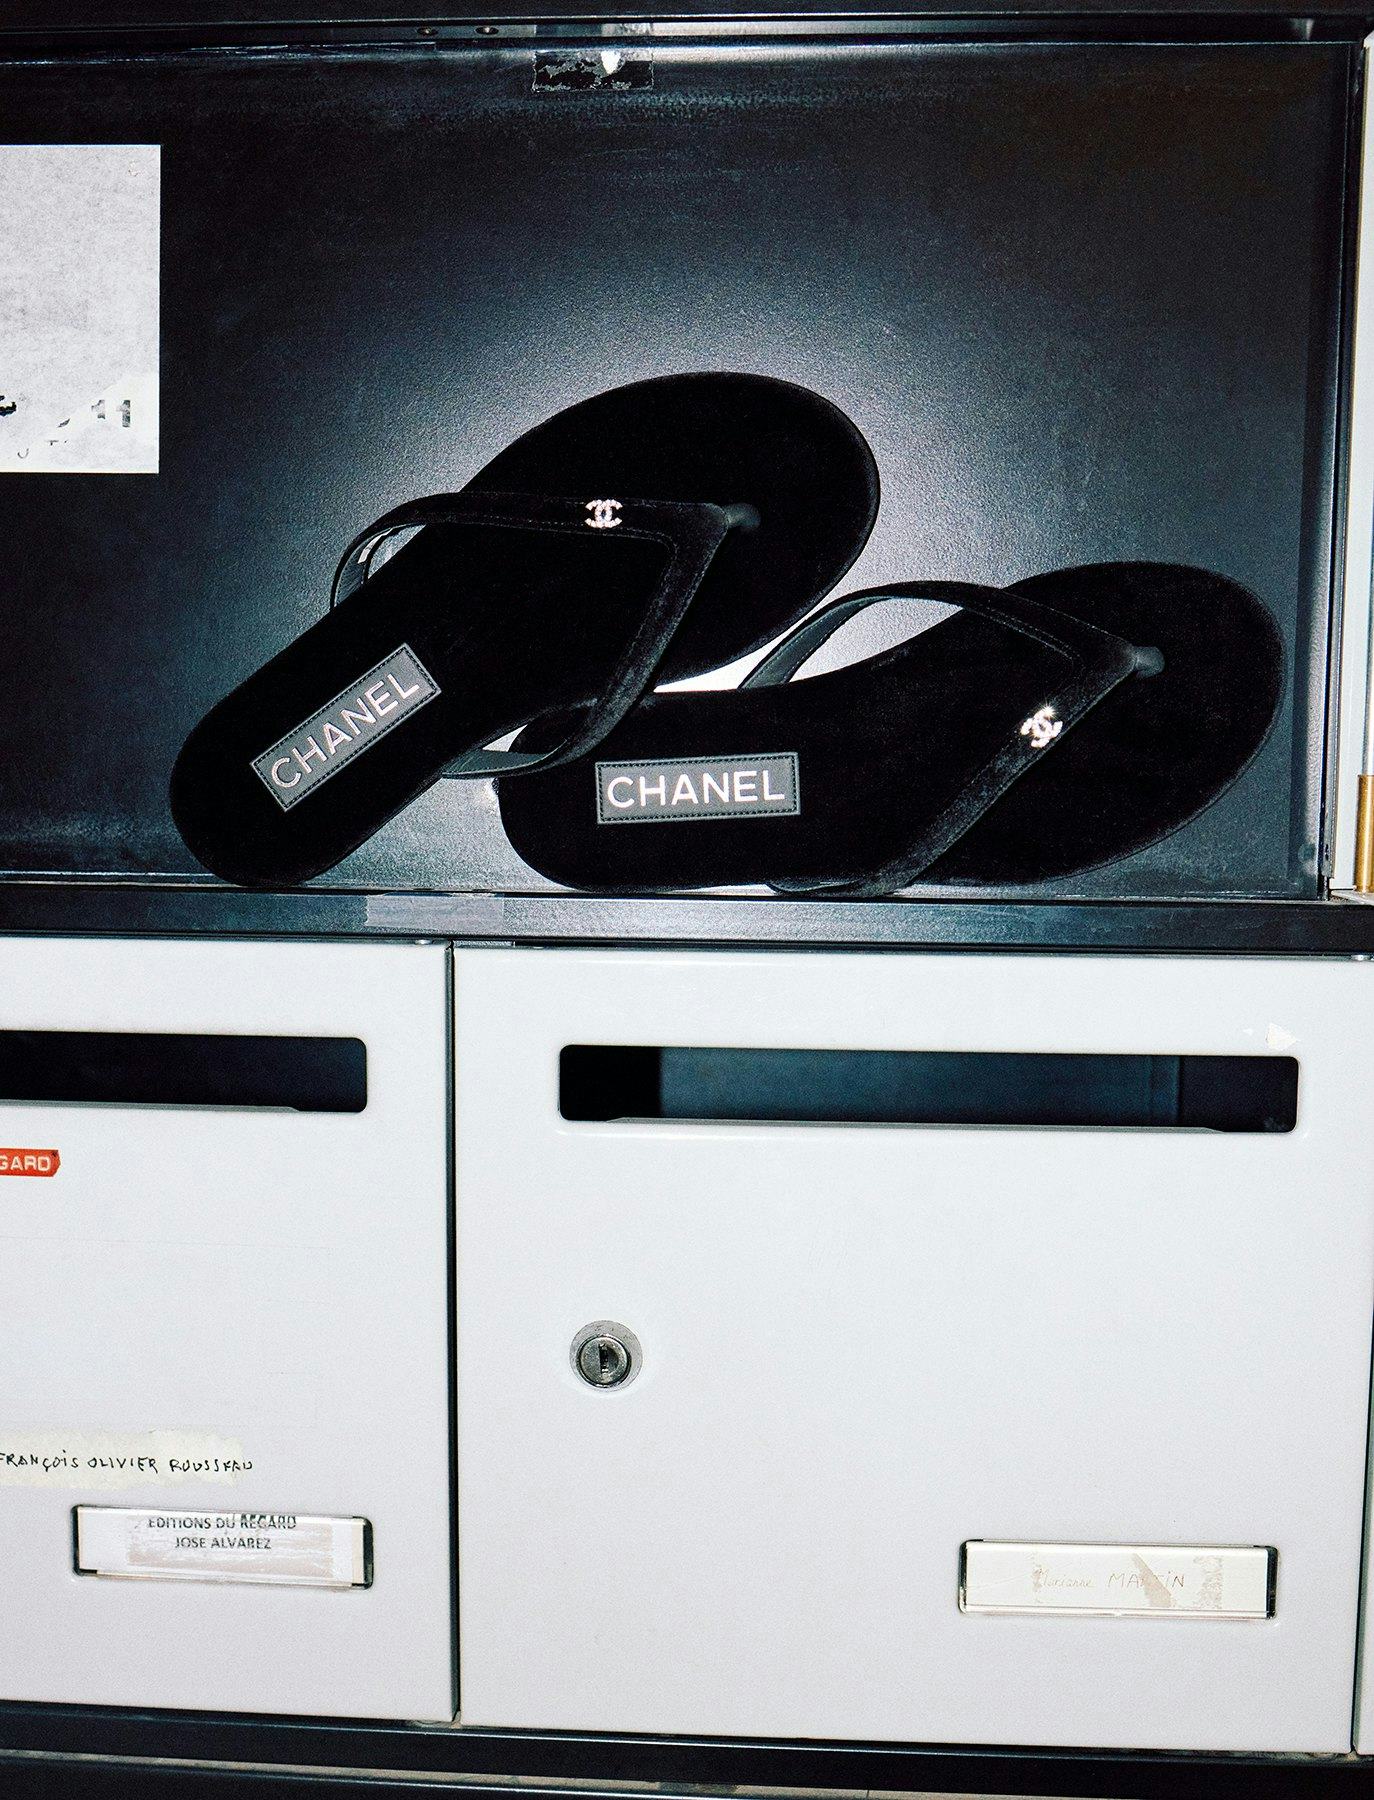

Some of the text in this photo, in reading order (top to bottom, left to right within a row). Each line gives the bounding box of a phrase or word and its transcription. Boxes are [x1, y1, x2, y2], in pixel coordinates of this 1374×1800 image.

[270, 673, 420, 788] CHANEL
[606, 769, 786, 809] CHANEL
[87, 1456, 159, 1474] OLIVIER
[148, 1513, 297, 1530] EDITIONS DU REGARD
[174, 1536, 272, 1550] JOSE ALVAREZ
